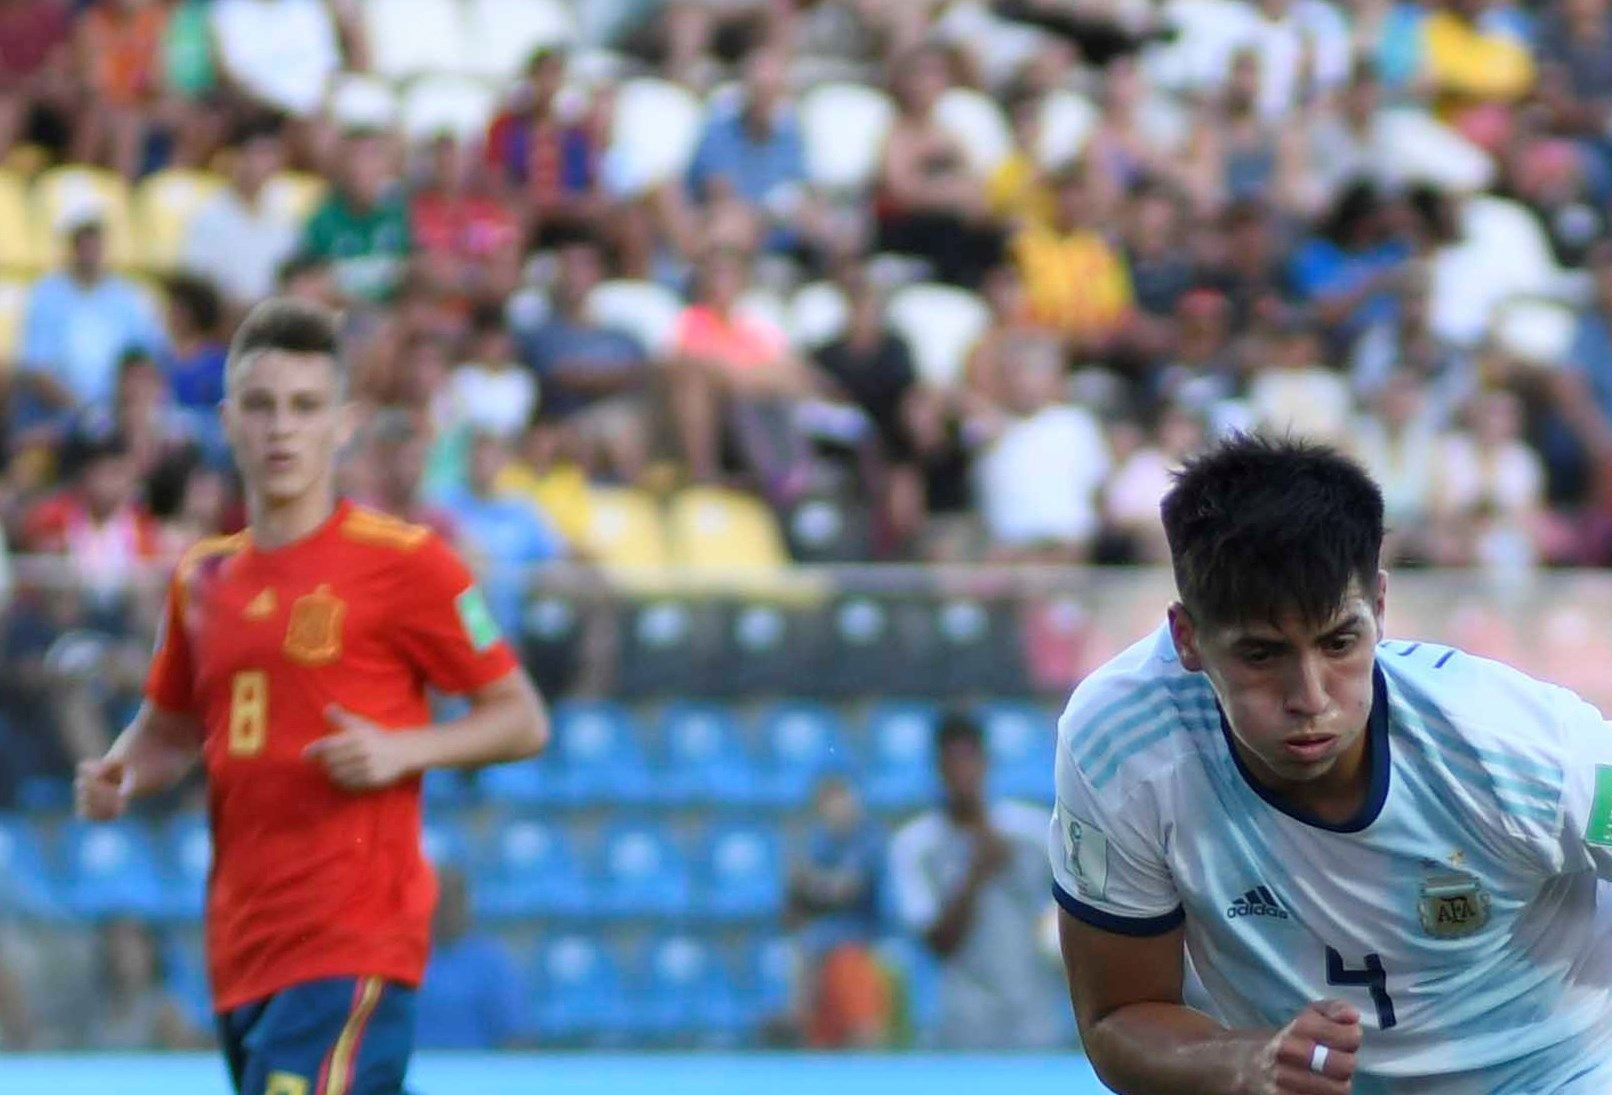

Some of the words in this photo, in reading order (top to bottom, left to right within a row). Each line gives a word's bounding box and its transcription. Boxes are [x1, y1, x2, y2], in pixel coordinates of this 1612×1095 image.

[228, 668, 269, 757] 8
[1226, 903, 1289, 919] adidas
[1326, 945, 1397, 1031] 4
